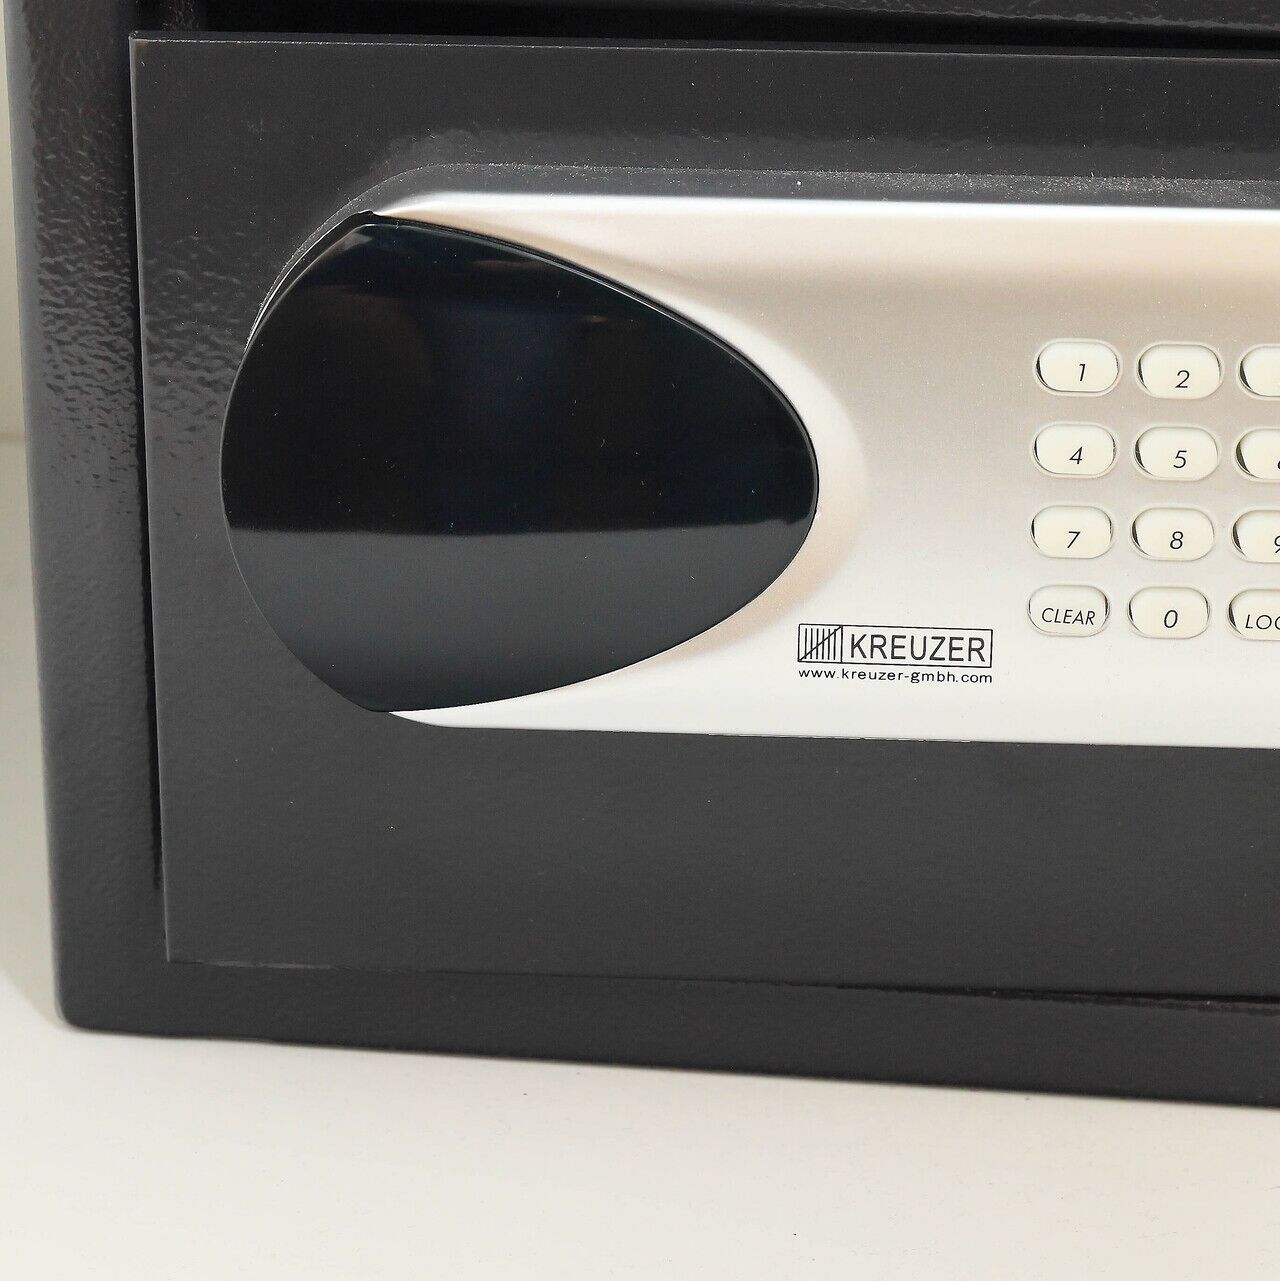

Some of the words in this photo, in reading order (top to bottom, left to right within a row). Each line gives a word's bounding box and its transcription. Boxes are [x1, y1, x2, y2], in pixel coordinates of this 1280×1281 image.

[1174, 369, 1191, 389] 2
[1067, 446, 1084, 465] 4
[1171, 449, 1189, 469] 5
[1065, 530, 1082, 549] 7
[1168, 530, 1185, 550] 8
[1041, 607, 1096, 626] CLEAR
[1162, 609, 1180, 629] 0
[850, 633, 986, 663] KREUZER
[798, 668, 993, 684] www.kreuzer-gmbh.com
